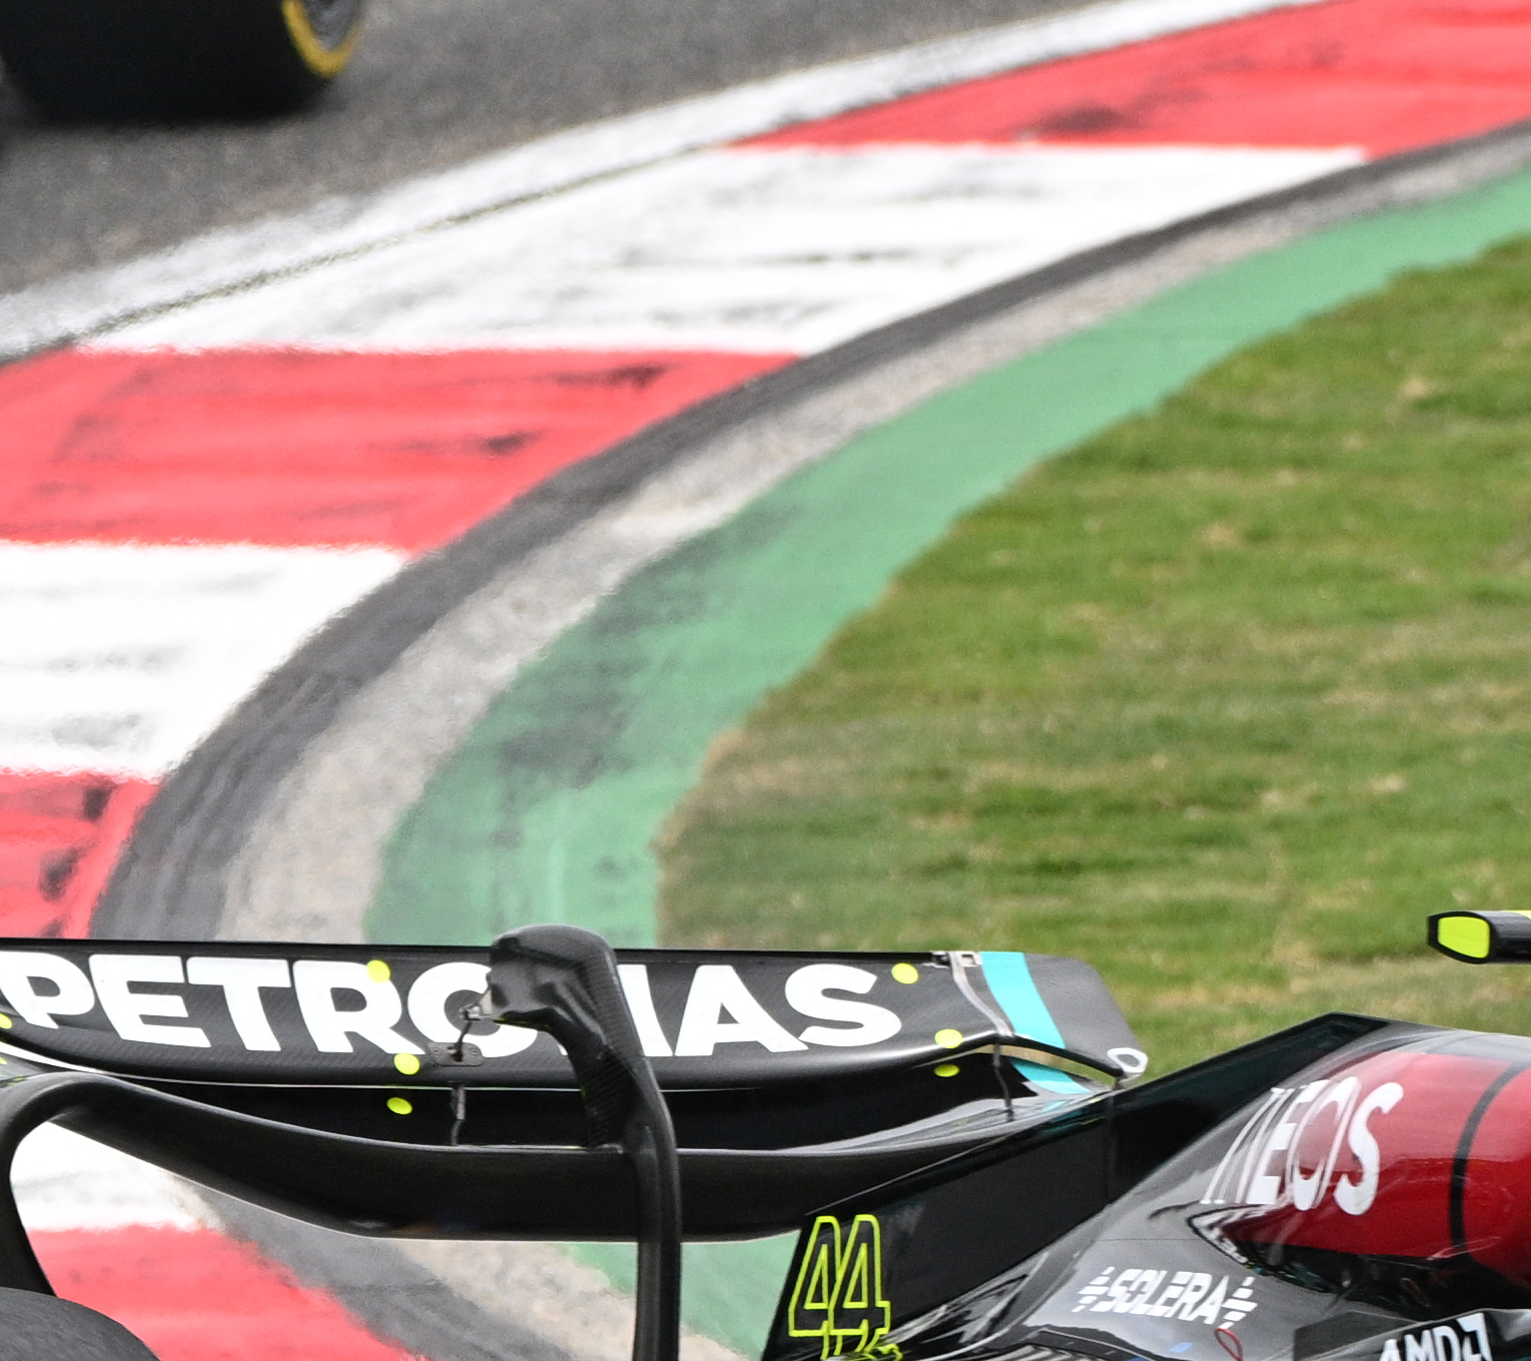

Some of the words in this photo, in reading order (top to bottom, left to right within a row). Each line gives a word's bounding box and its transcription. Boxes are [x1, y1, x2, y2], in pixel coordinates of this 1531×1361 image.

[1199, 1075, 1404, 1216] INEOS
[788, 1214, 892, 1361] 44
[1103, 1268, 1229, 1327] SOLERA
